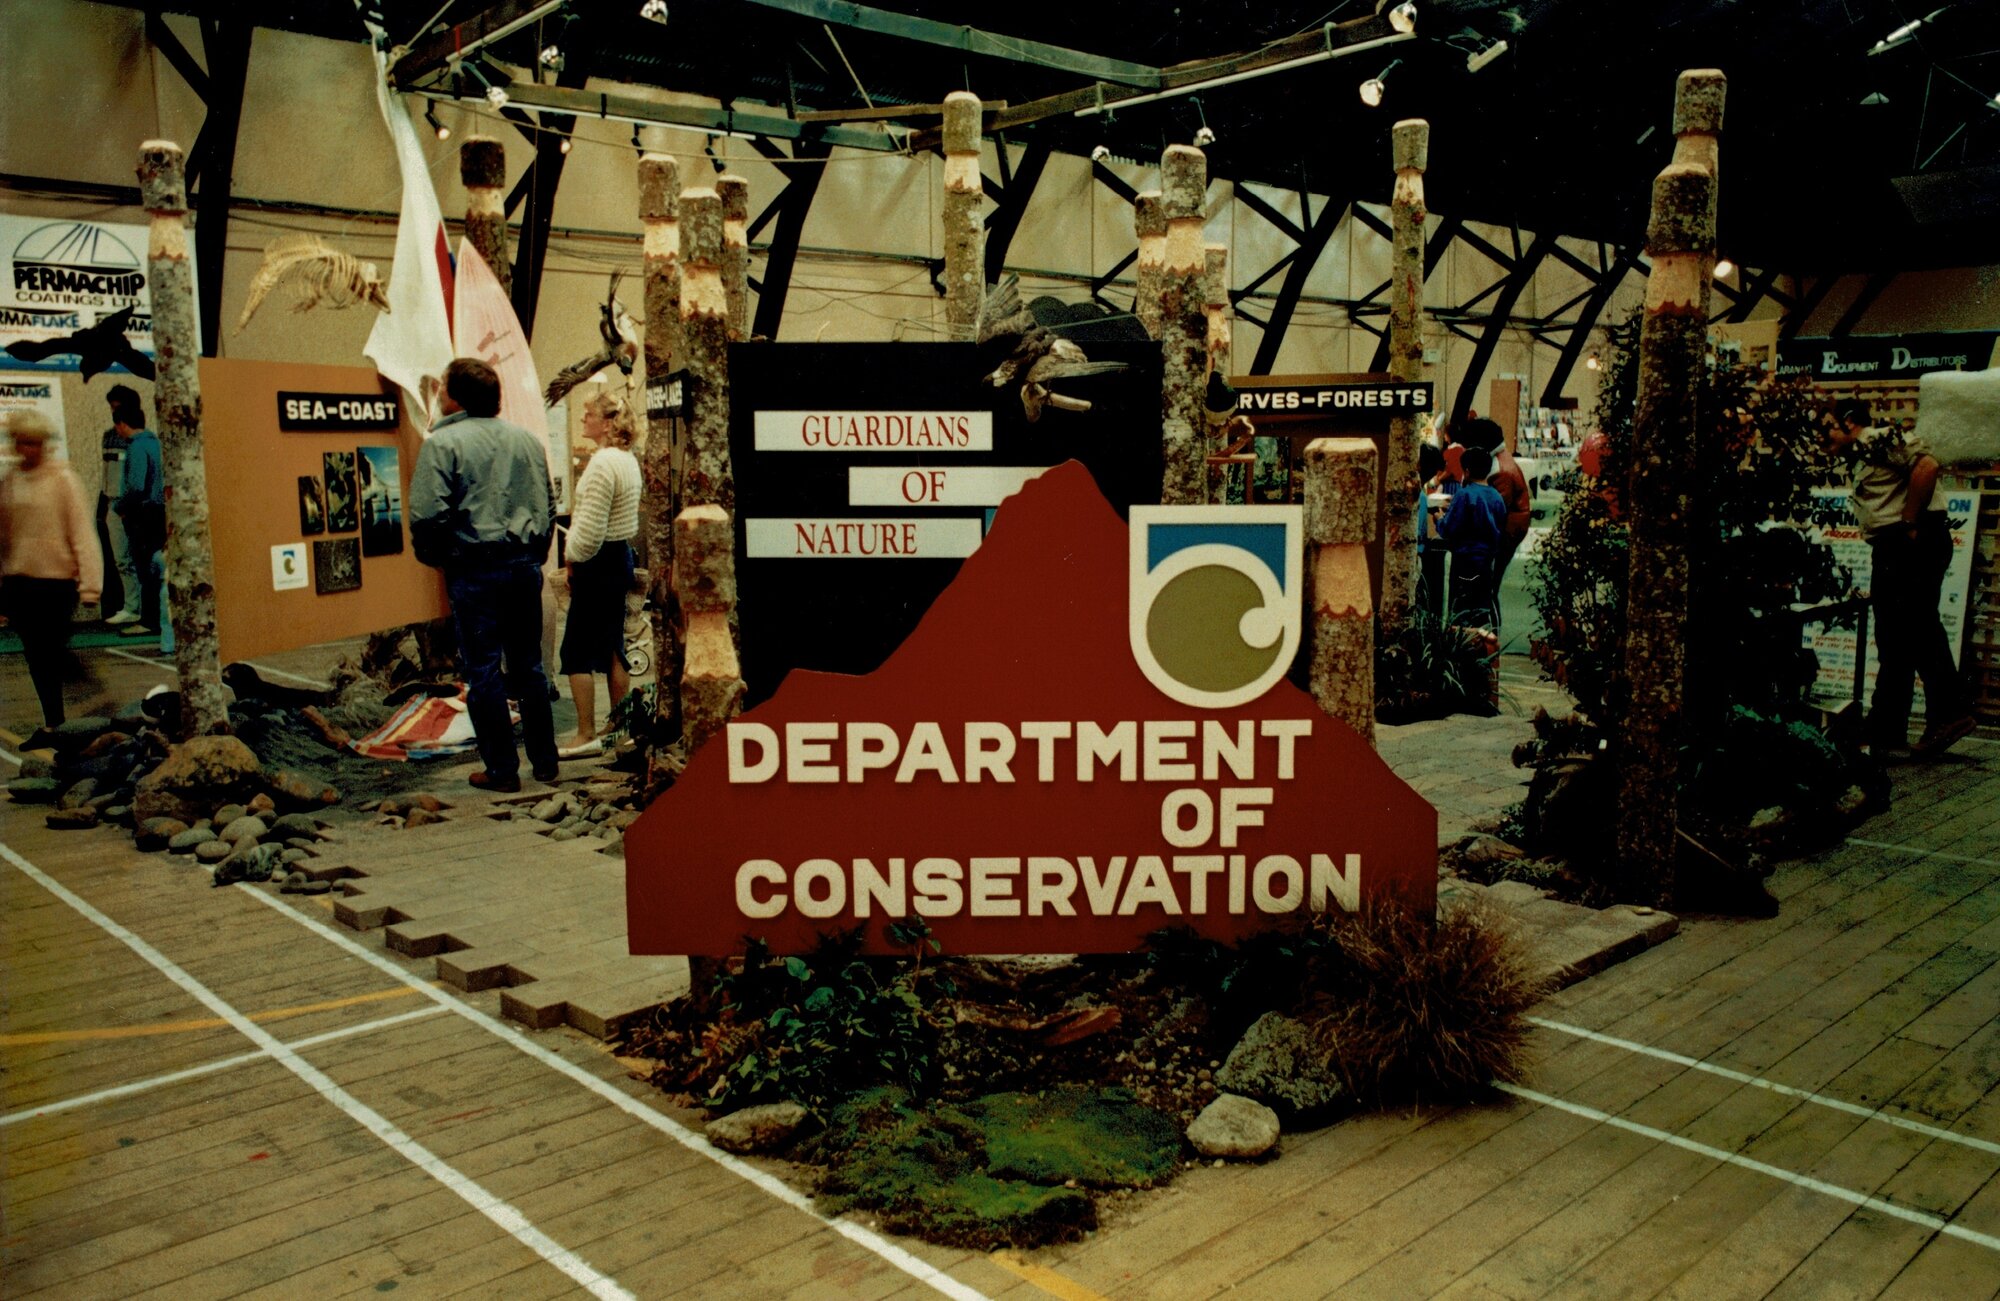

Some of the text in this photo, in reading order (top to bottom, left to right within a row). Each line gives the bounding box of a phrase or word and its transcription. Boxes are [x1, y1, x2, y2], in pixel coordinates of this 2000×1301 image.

[13, 268, 146, 296] PERMACHIP
[16, 291, 104, 306] COATINGS
[286, 399, 396, 421] SEA-COAST
[1239, 389, 1427, 410] RVES-FORESTS
[802, 415, 970, 447] GUARDIANS
[901, 471, 947, 503] OF
[1948, 498, 1971, 512] ON
[794, 523, 919, 555] NATURE
[726, 719, 1313, 784] DEPARTMENT
[1160, 787, 1274, 848] OF
[735, 853, 1361, 919] CONSERVATION
